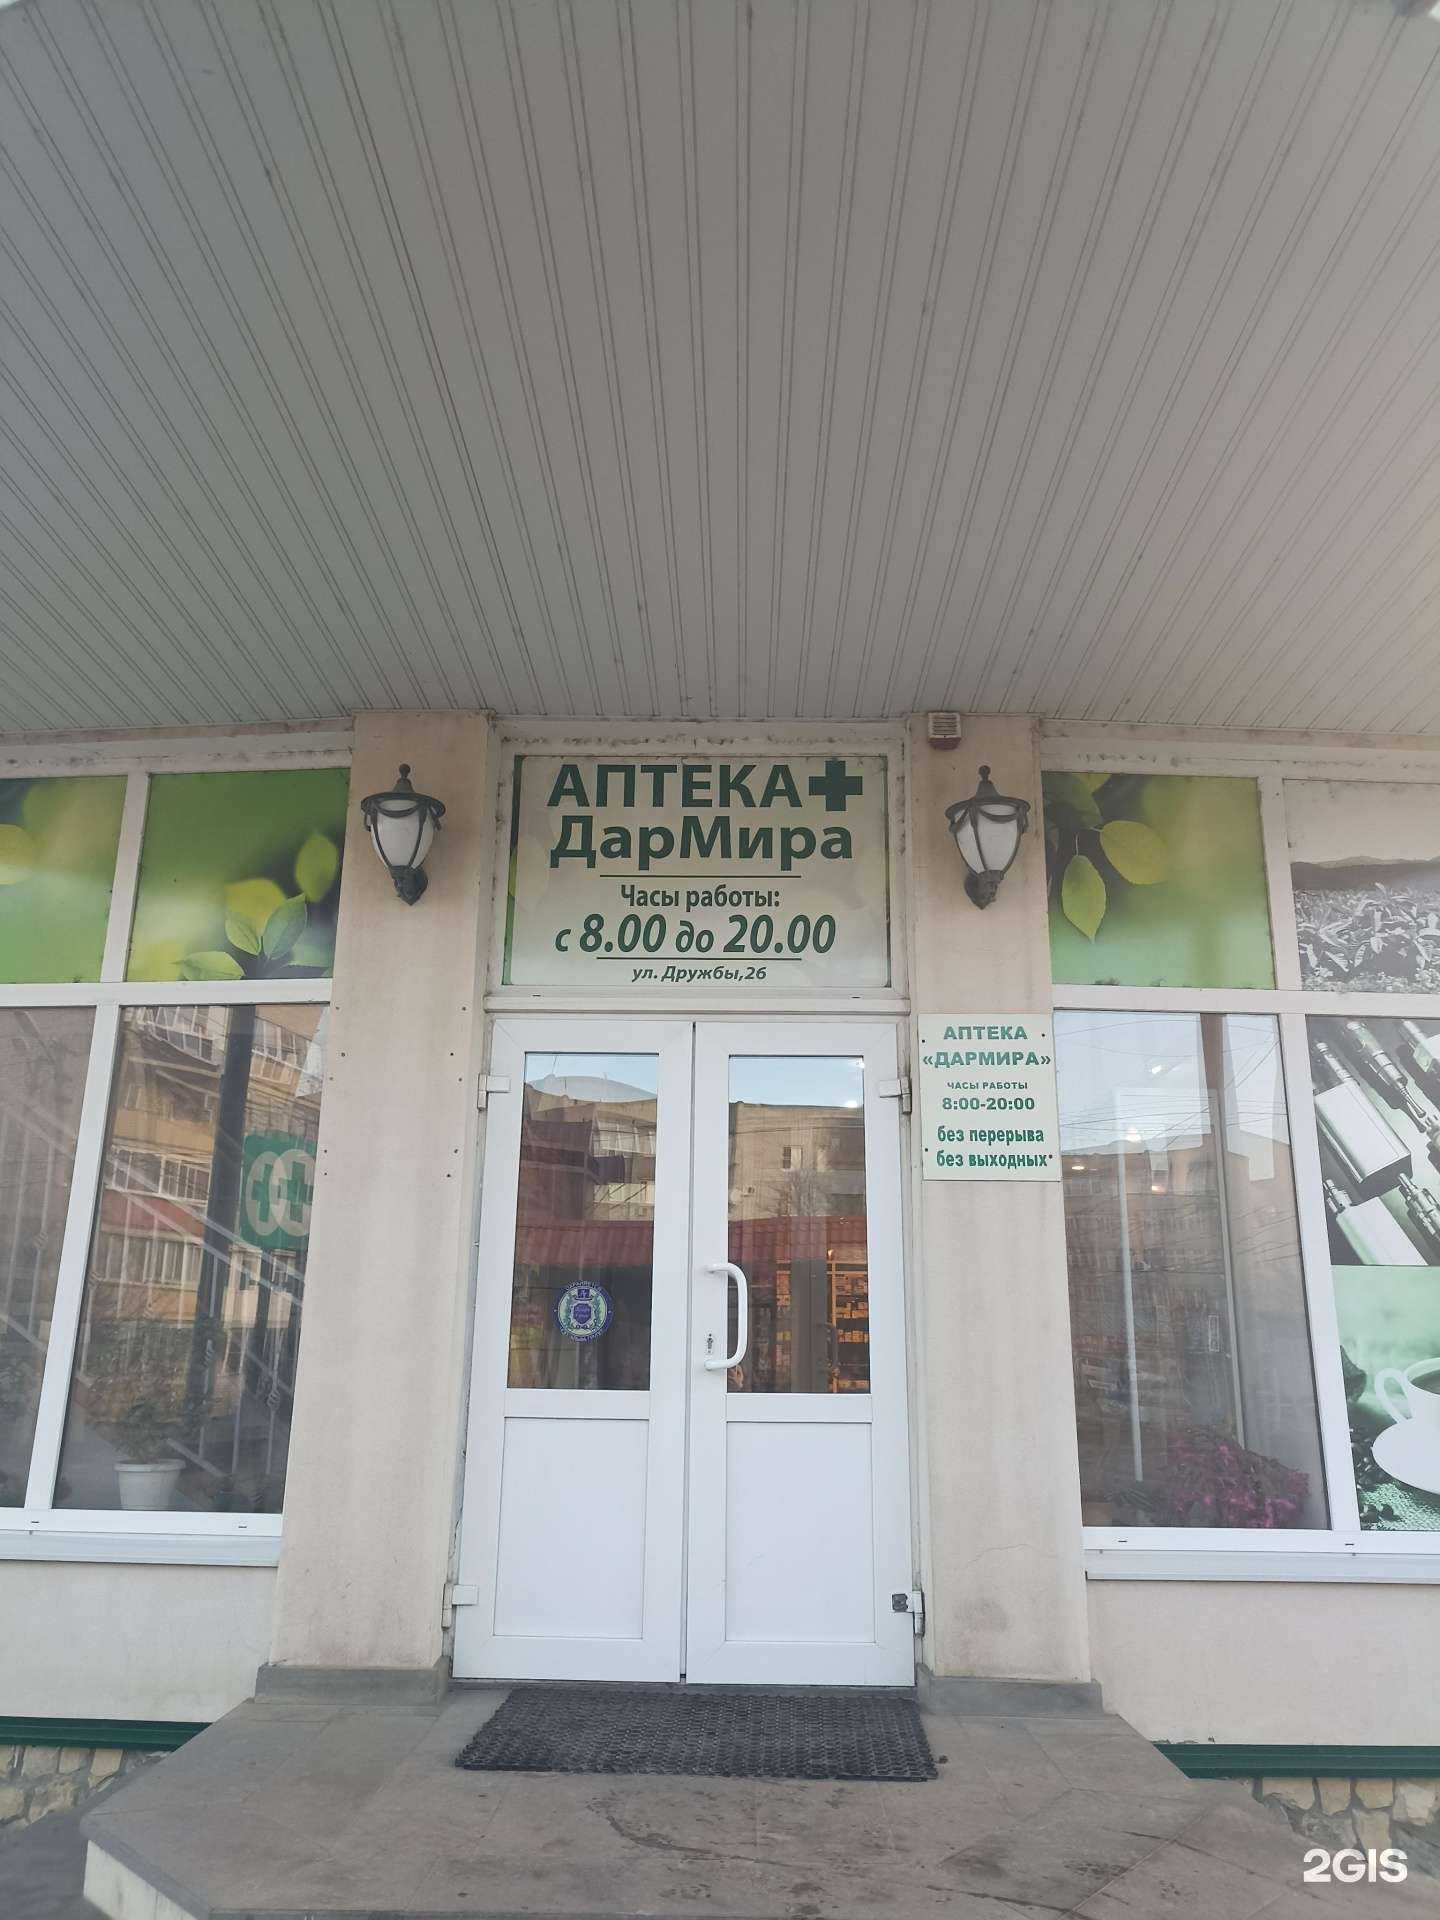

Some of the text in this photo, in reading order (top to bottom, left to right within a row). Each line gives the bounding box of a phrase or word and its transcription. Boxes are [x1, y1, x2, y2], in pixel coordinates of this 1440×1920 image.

[547, 764, 802, 808] АПТЕКА
[550, 815, 853, 871] ДарМира
[621, 884, 780, 912] Часы работы:
[555, 913, 836, 953] с 8.00 до 20.00
[631, 965, 767, 983] ул. Дружбы,26
[943, 1026, 1028, 1040] АПТЕКА
[922, 1051, 1051, 1068] «ДАРМИРА»
[947, 1081, 1028, 1090] ЧАСЫ РАБОТЫ
[942, 1097, 1035, 1110] 8:00-20:00
[937, 1125, 1045, 1146] без перерыва
[936, 1150, 1048, 1169] без выходных
